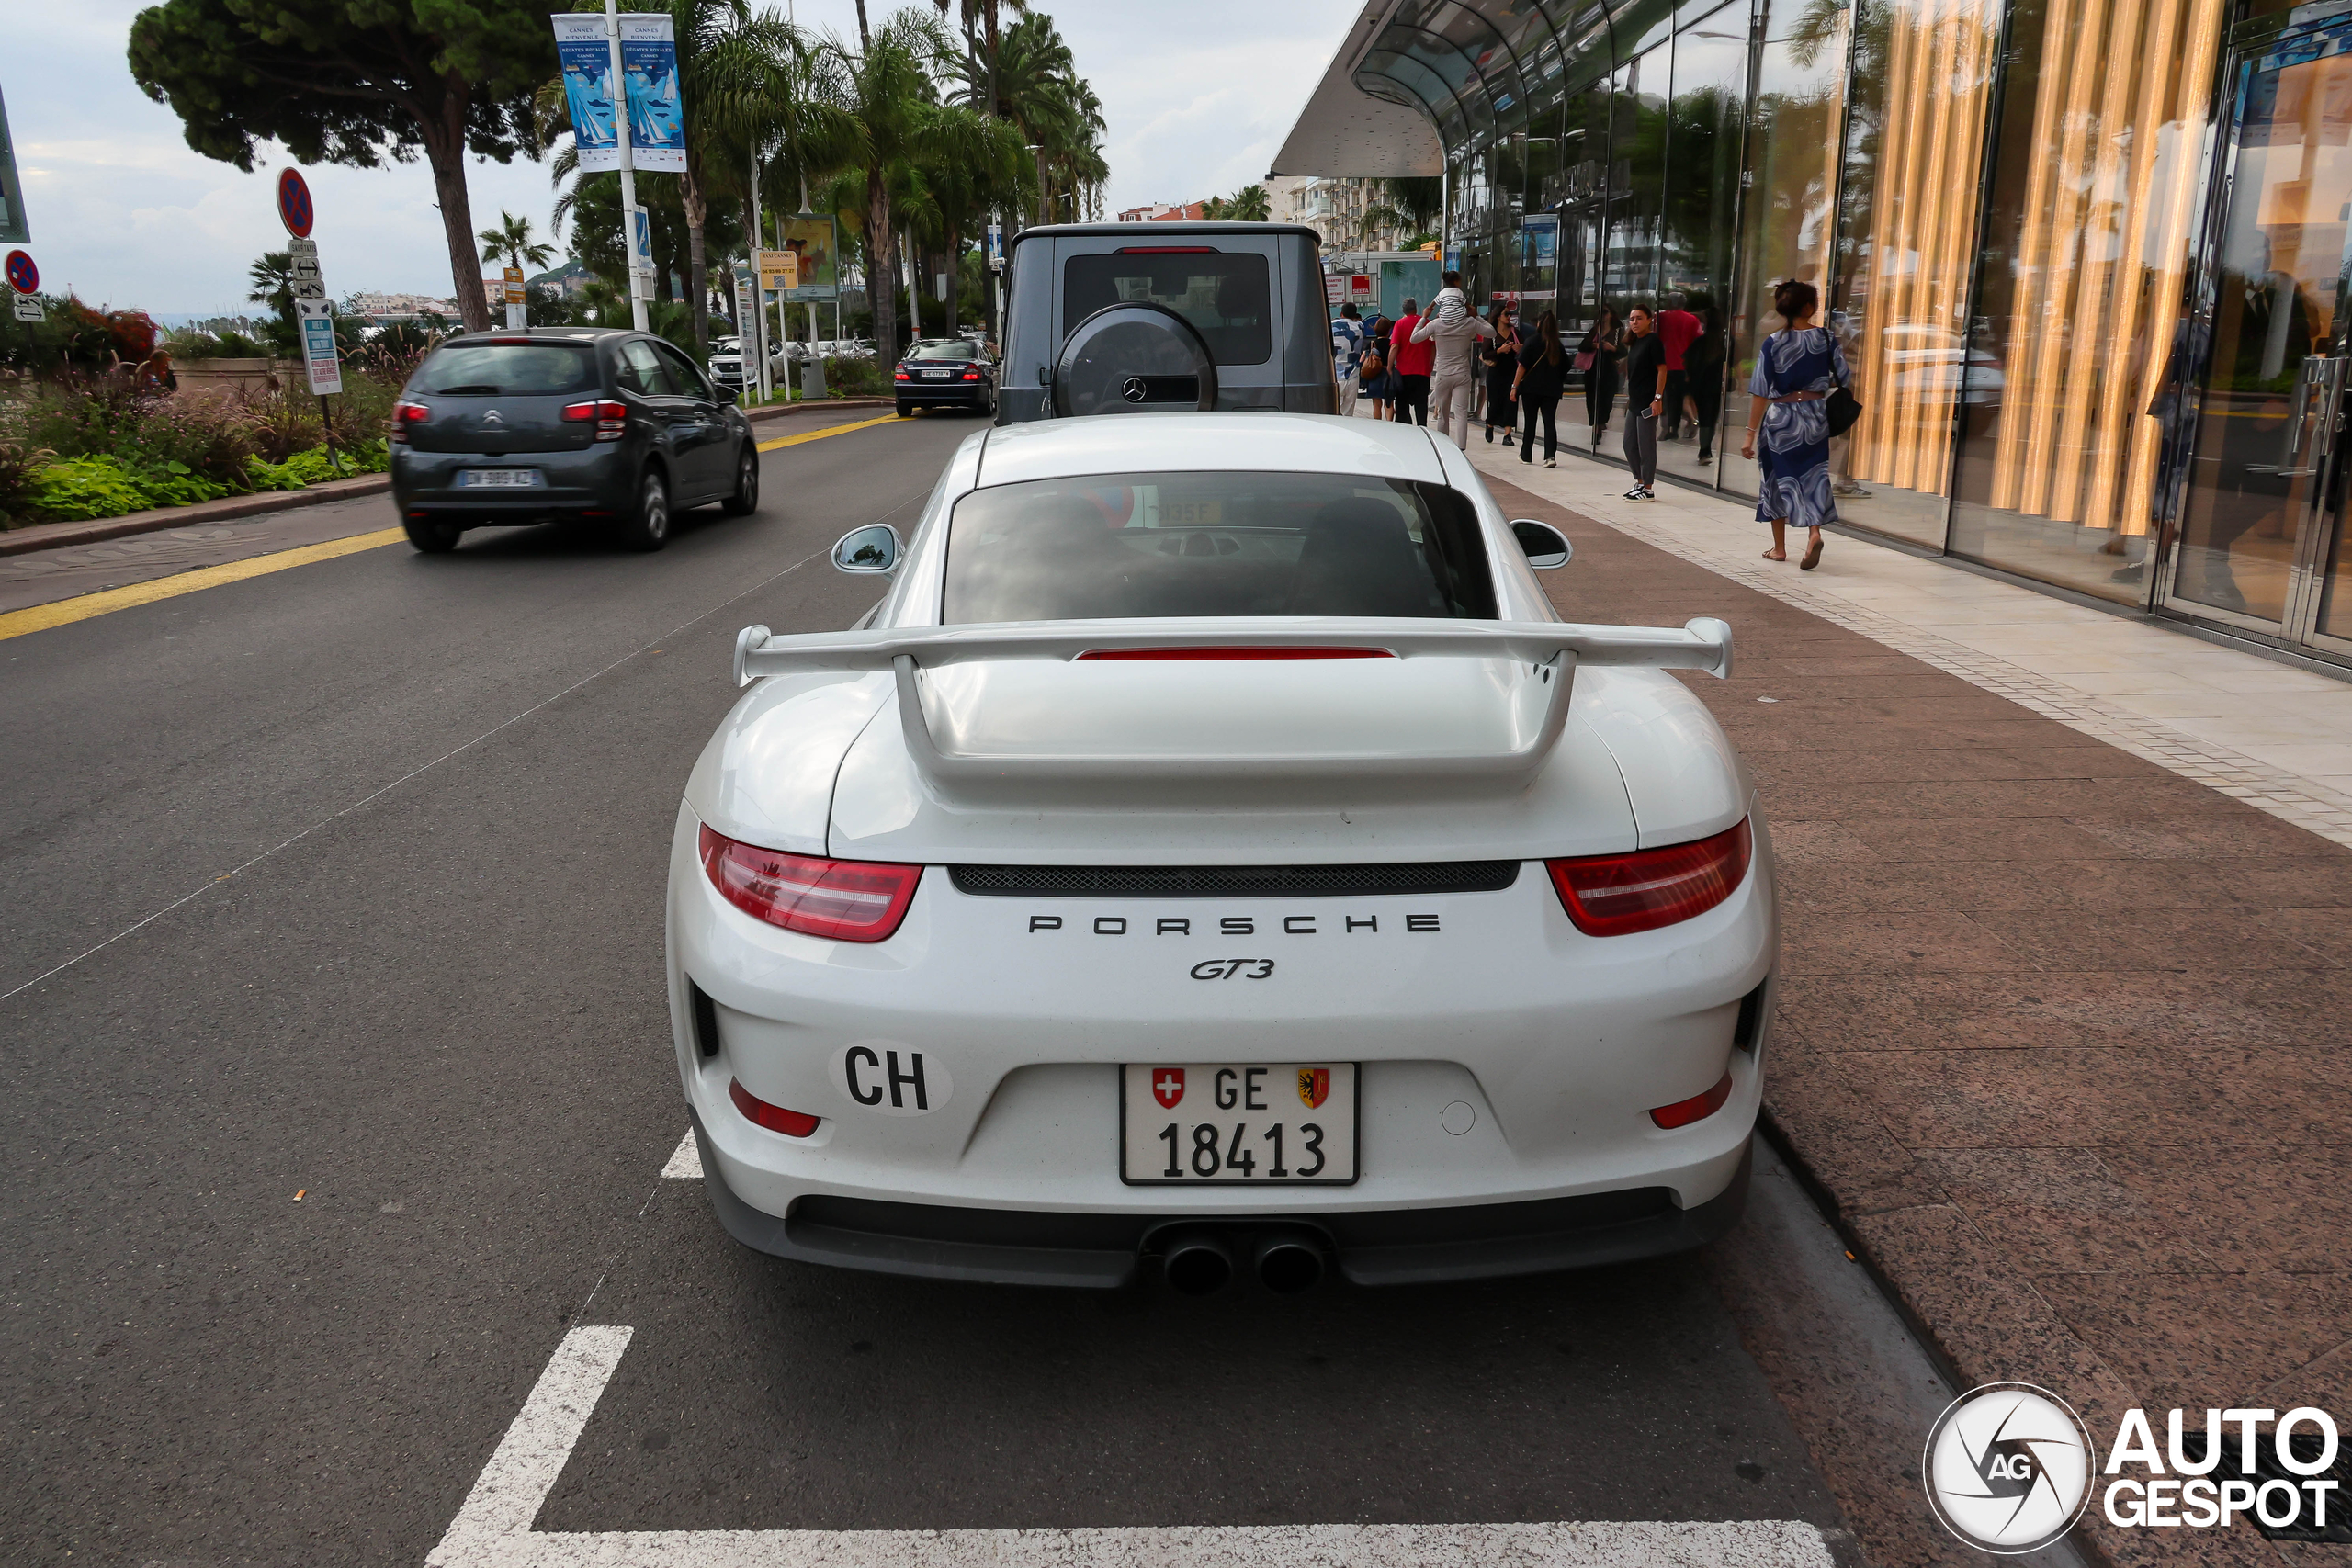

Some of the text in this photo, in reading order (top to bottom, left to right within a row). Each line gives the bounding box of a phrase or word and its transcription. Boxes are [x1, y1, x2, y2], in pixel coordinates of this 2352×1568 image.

[1029, 914, 1441, 936] PORSCHE
[1190, 958, 1275, 980] GT3
[845, 1046, 928, 1111] CH
[1215, 1068, 1268, 1110] GE
[1159, 1122, 1325, 1177] 18413
